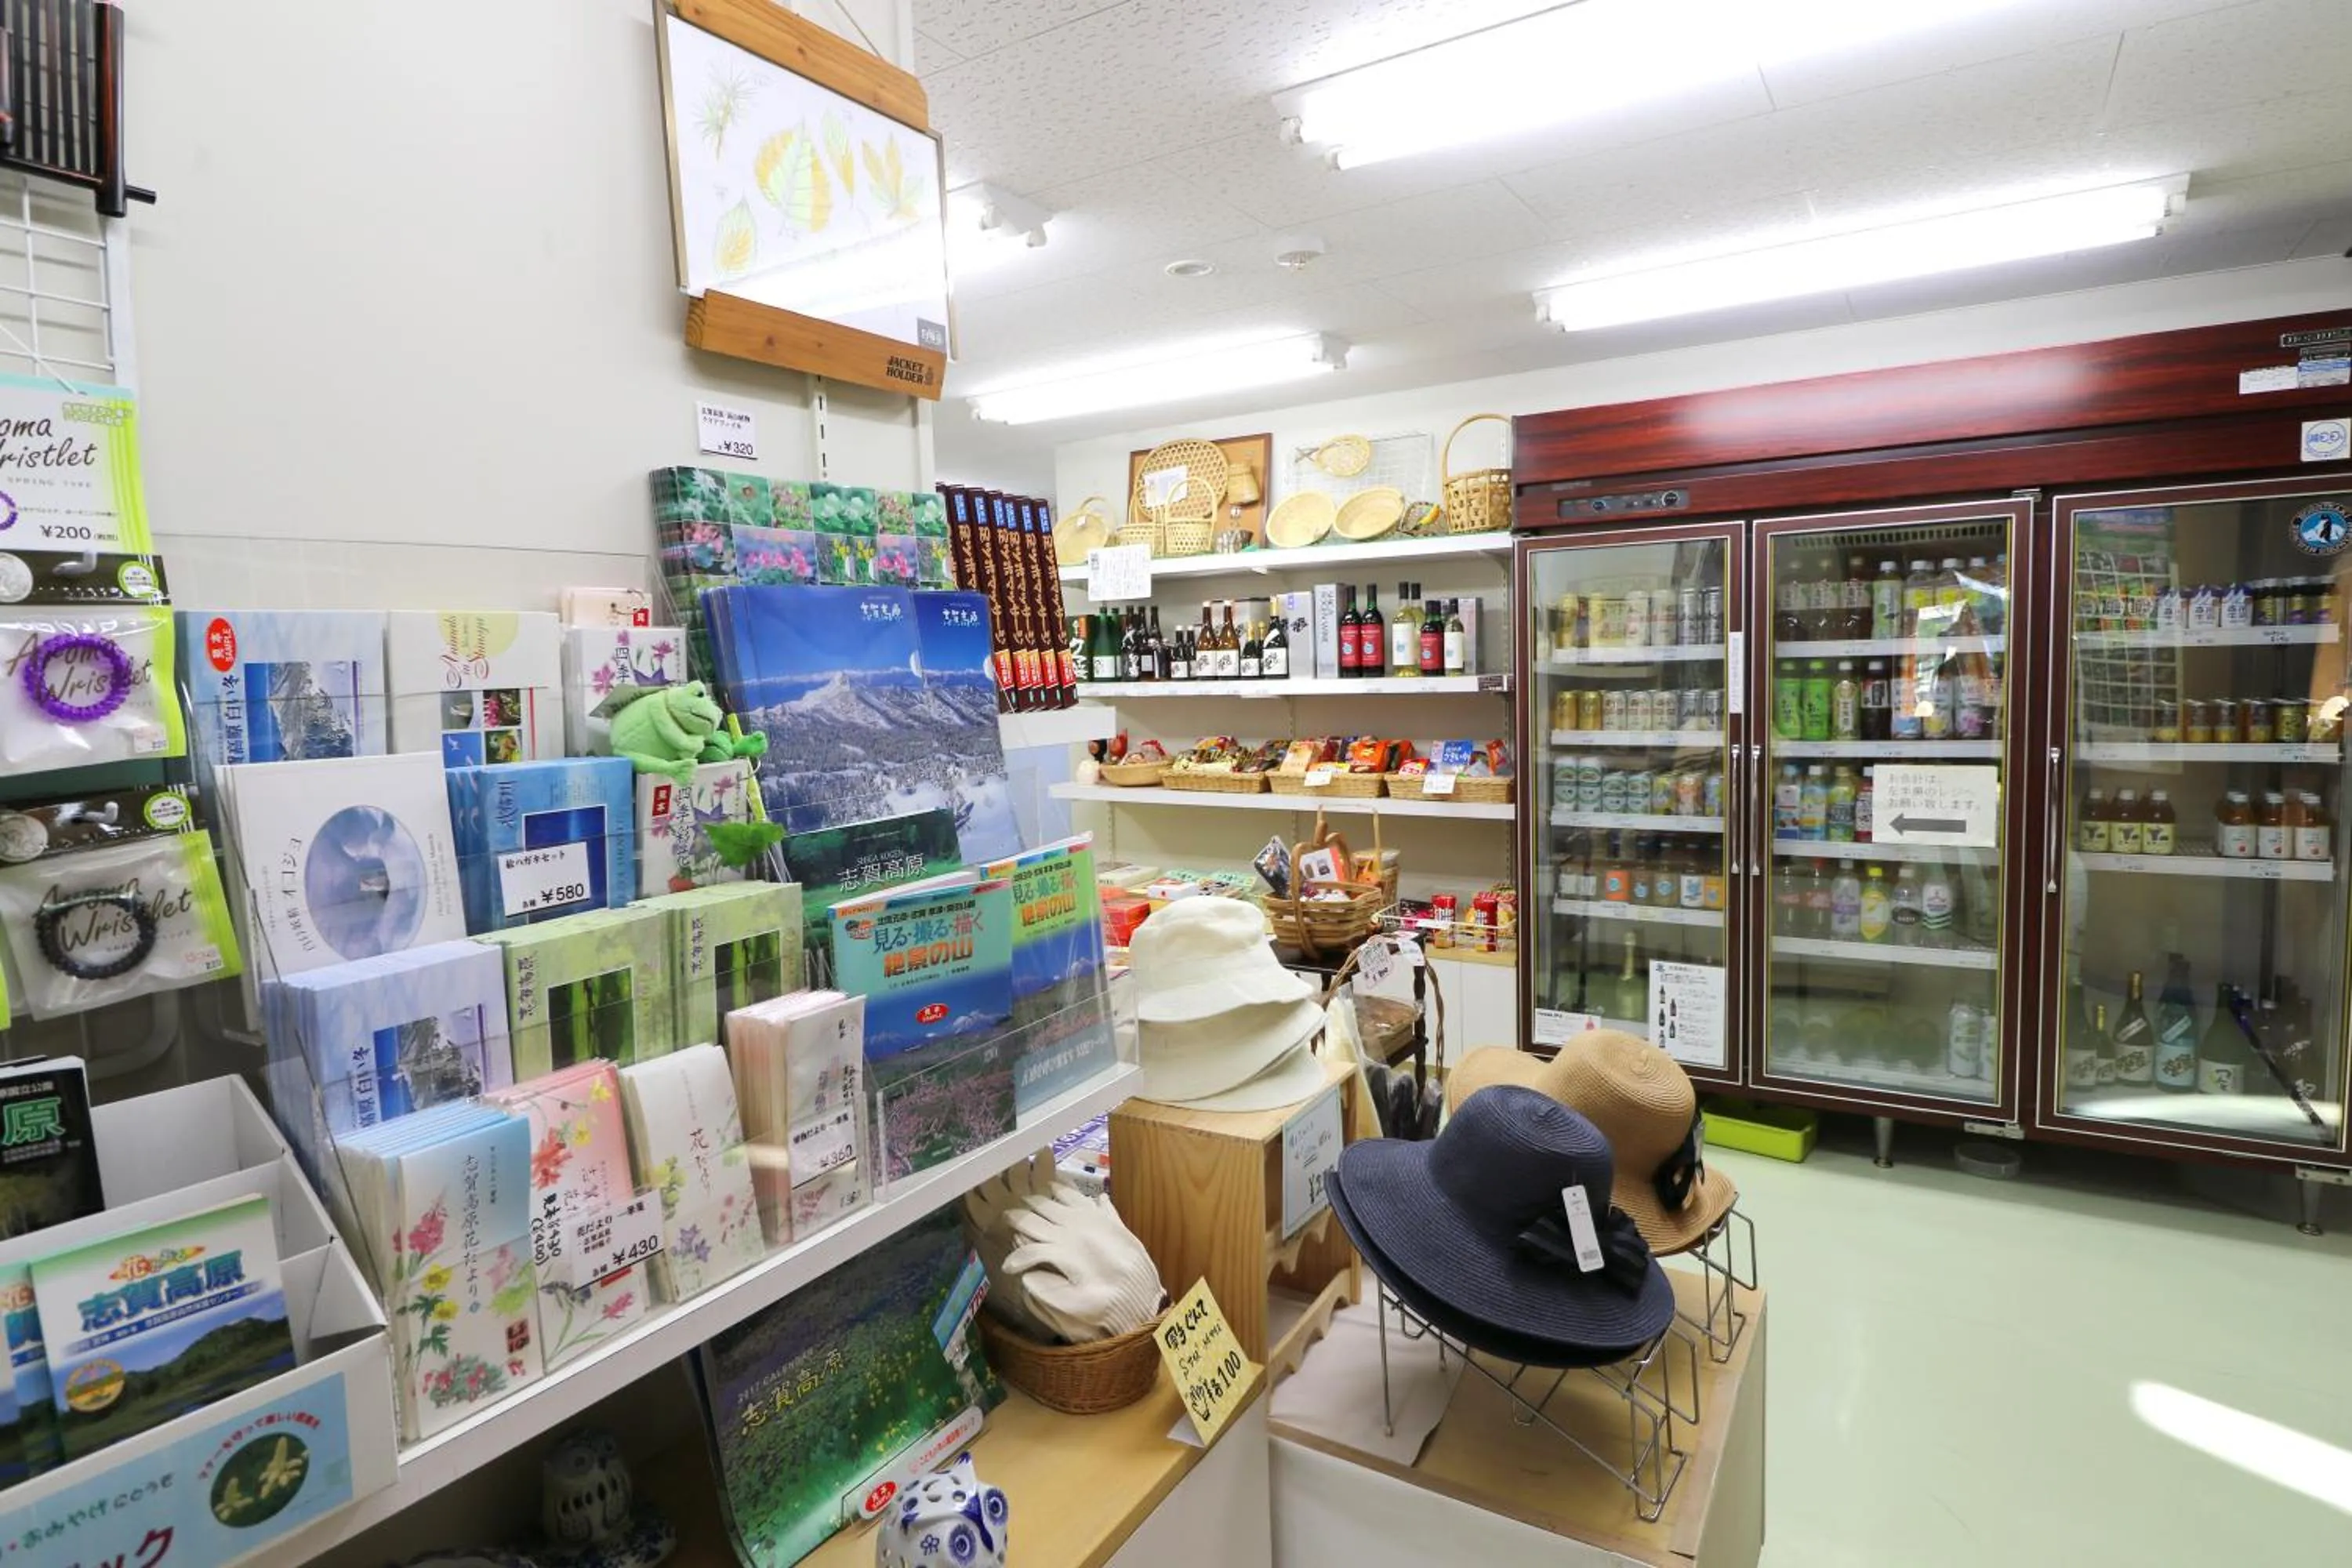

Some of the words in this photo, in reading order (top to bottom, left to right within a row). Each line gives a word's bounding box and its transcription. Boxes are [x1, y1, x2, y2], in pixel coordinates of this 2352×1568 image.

[886, 366, 924, 384] HOLDER
[887, 355, 924, 372] JACKET
[0, 437, 97, 467] ristlet
[723, 441, 753, 456] ¥320
[40, 524, 92, 541] ¥200
[223, 627, 234, 664] SAMPLE
[505, 851, 566, 869] 絵ハガキセット
[837, 852, 927, 893] 志賀高原
[541, 883, 585, 904] ¥580
[1020, 893, 1076, 927] 絶景の山
[872, 909, 985, 955] 見る・撮る・描く
[883, 939, 974, 978] 絶景の山
[2, 1096, 67, 1147] 原
[820, 1144, 854, 1168] ¥360
[612, 1235, 659, 1266] ¥430
[77, 1250, 246, 1332] 志賀高原
[741, 1348, 844, 1436] 志賀高原
